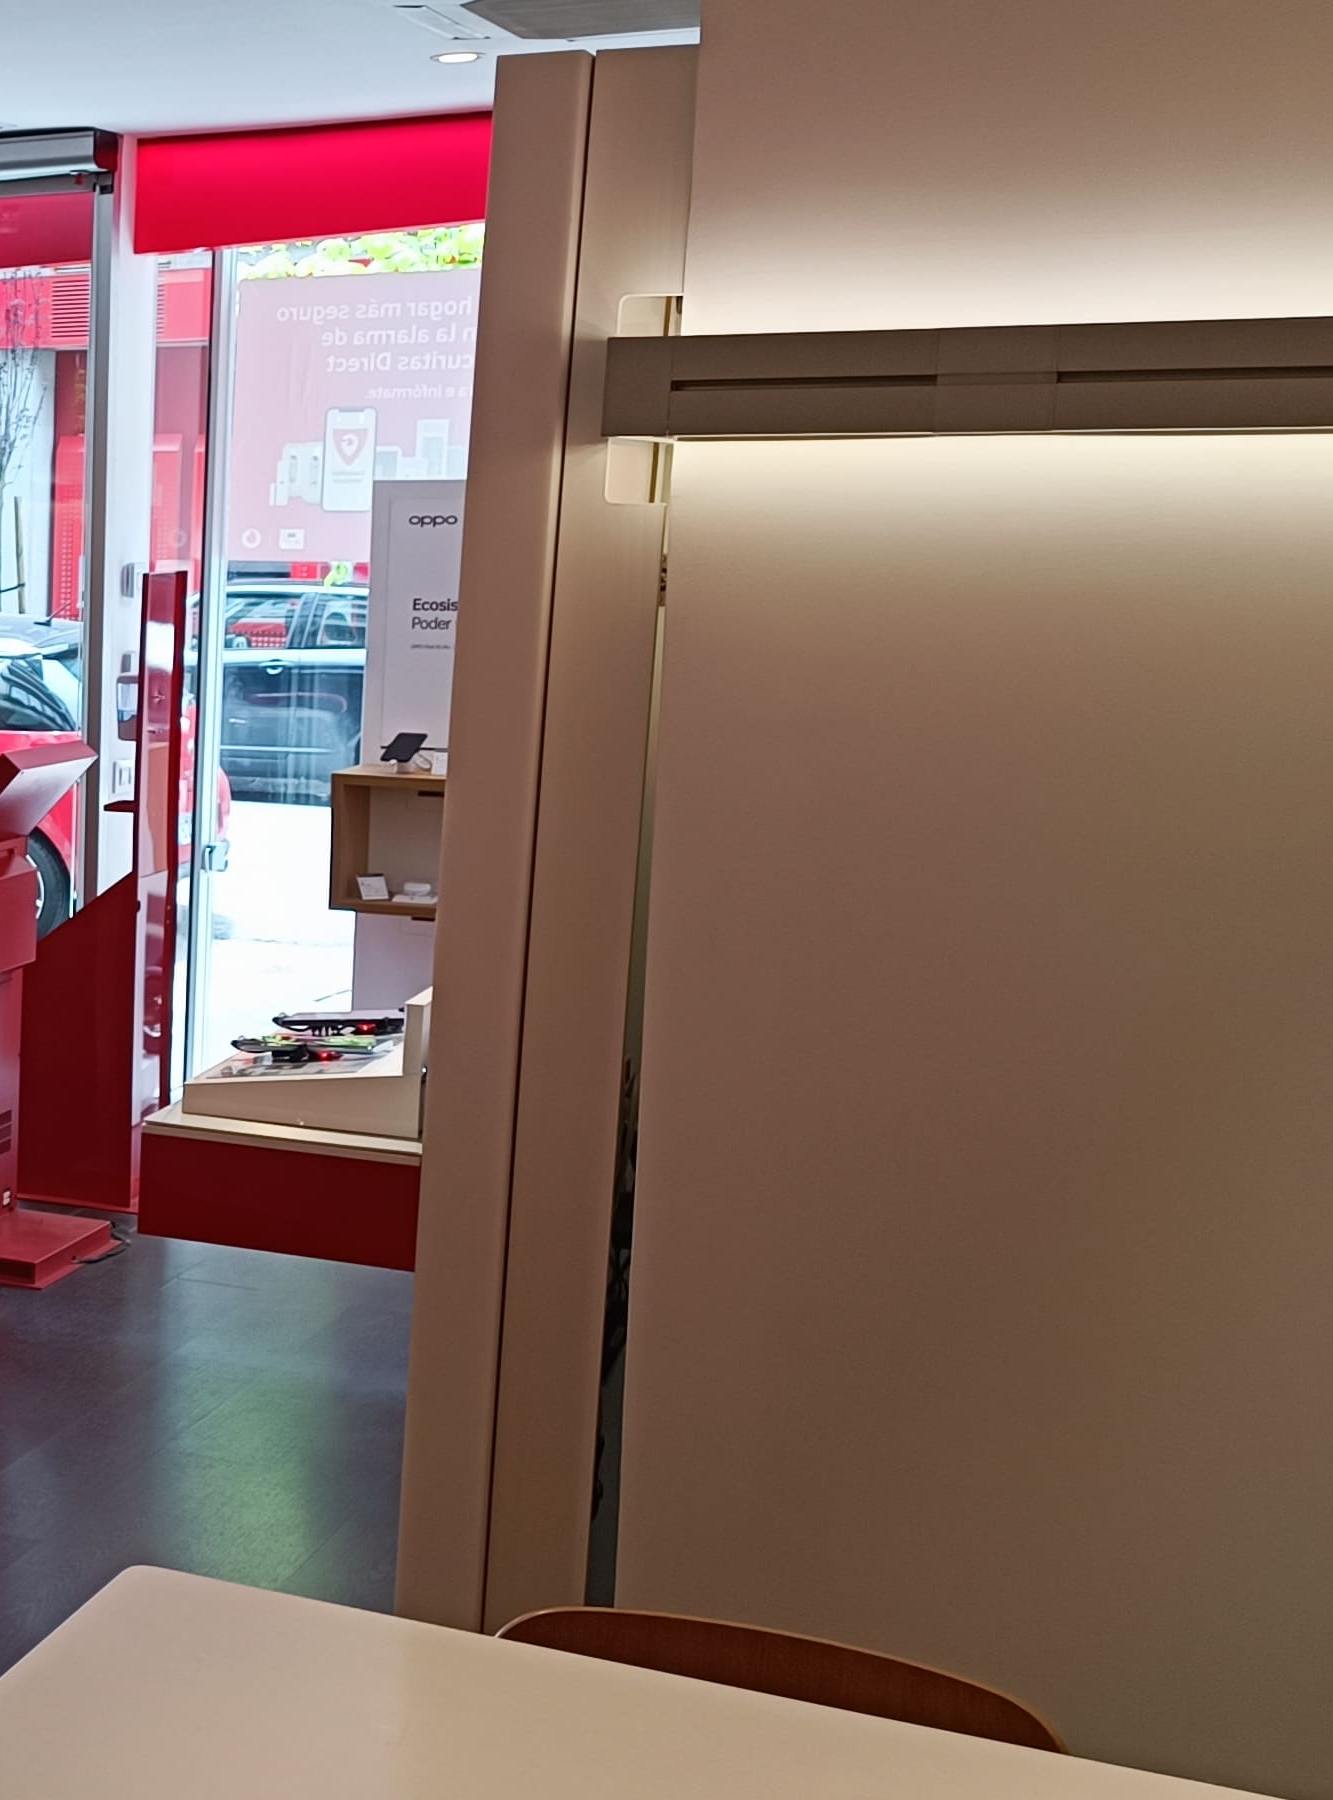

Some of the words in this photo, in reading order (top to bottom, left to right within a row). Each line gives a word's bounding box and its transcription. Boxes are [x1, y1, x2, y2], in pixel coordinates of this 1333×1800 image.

[409, 515, 458, 528] oppo
[412, 598, 459, 612] Ecosis
[411, 616, 451, 630] Poder
